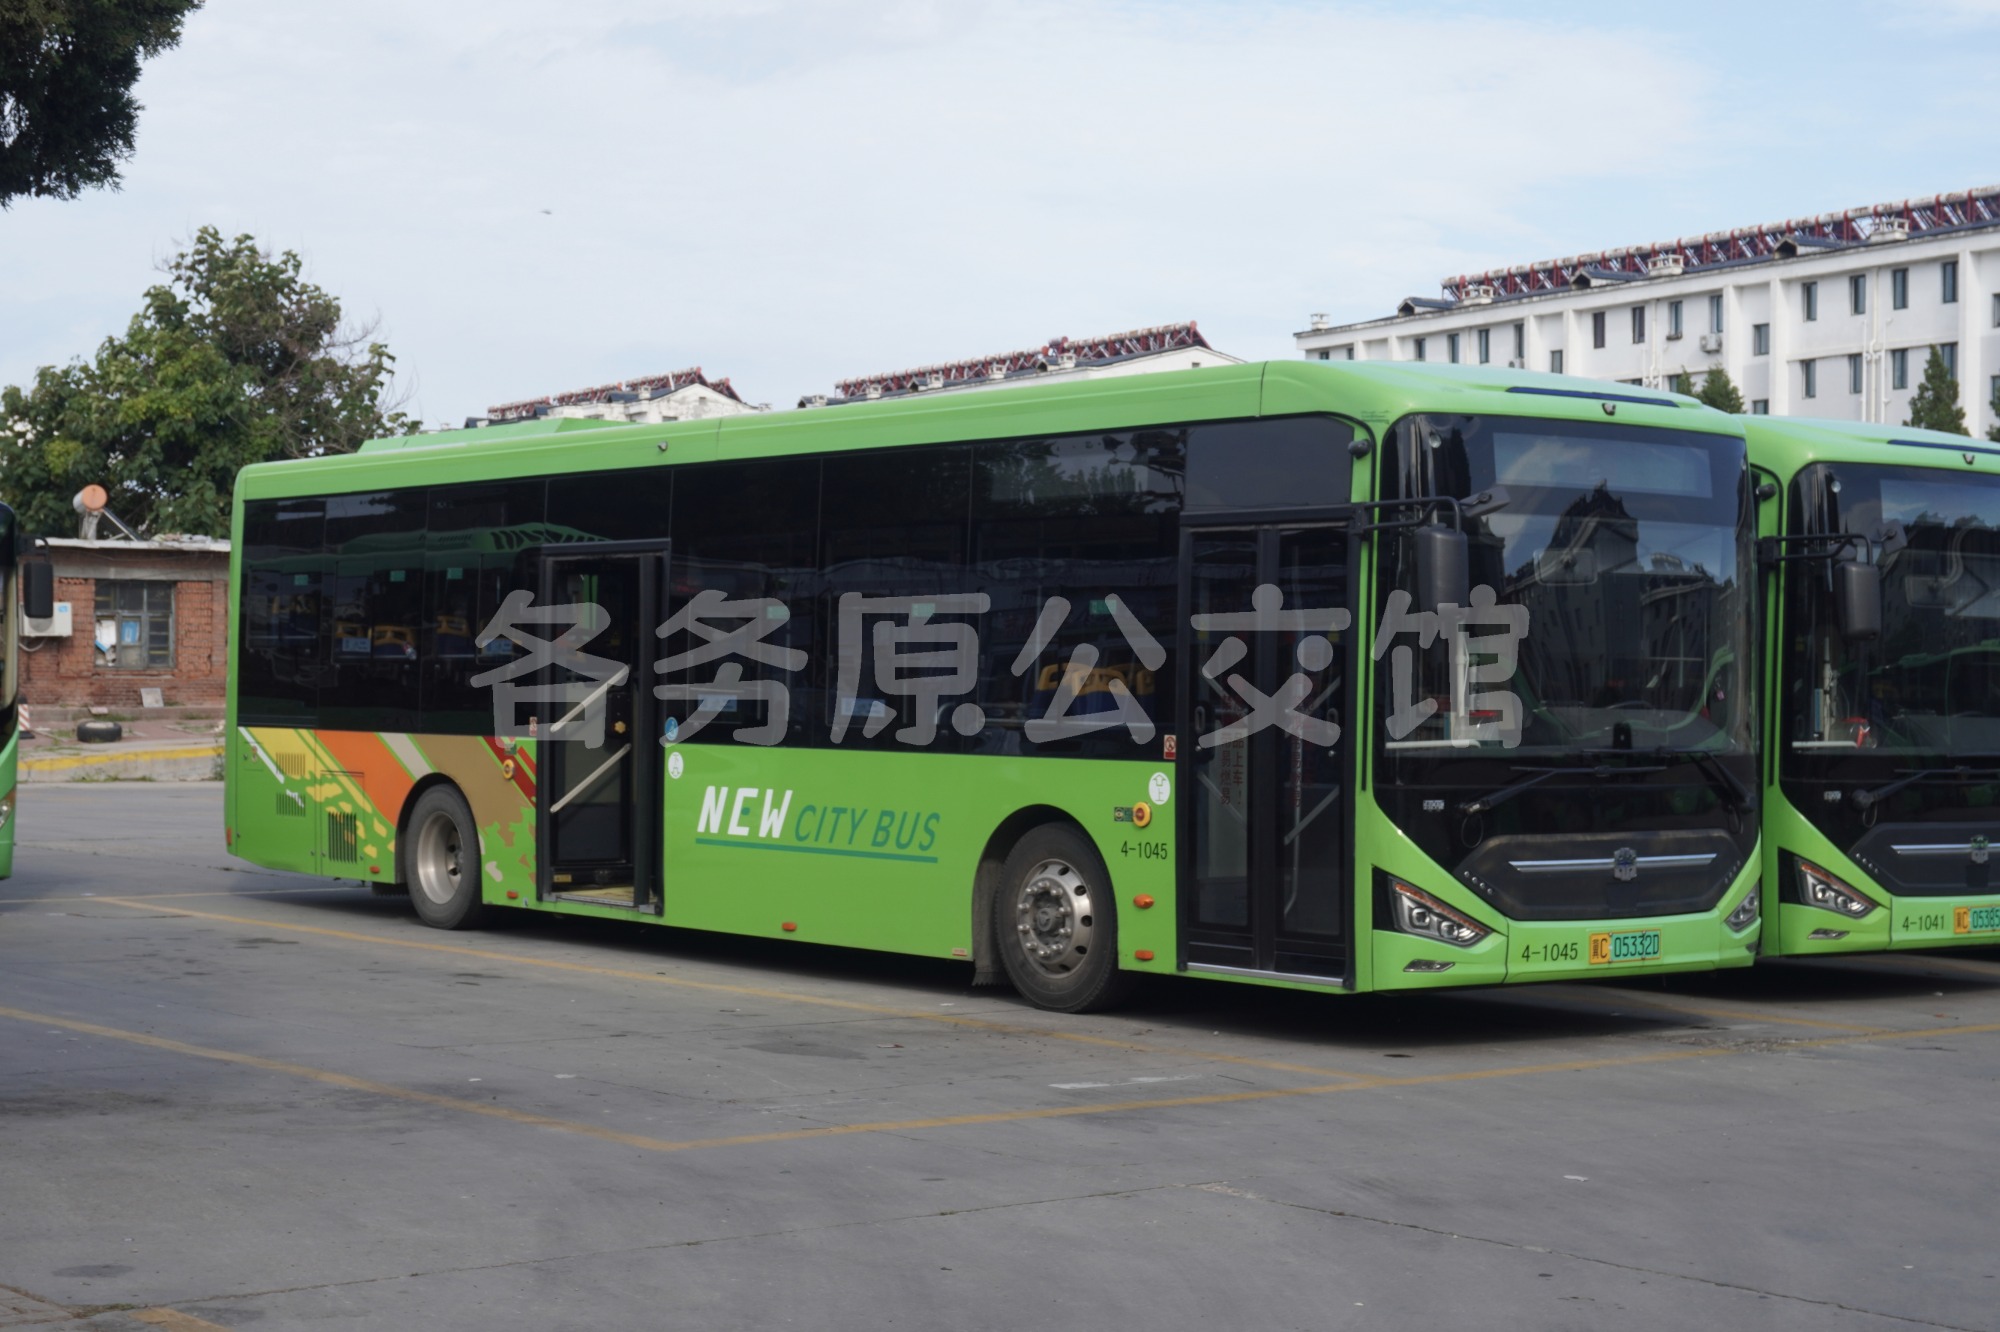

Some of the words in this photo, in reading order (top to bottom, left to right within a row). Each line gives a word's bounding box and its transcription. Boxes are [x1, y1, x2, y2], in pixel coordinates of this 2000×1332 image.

[697, 785, 793, 838] NEW
[794, 804, 868, 845] CITY
[871, 809, 941, 851] BUS
[1121, 840, 1168, 860] 4-1045
[1902, 914, 1945, 932] 4-1041
[1521, 942, 1579, 963] 4-1045
